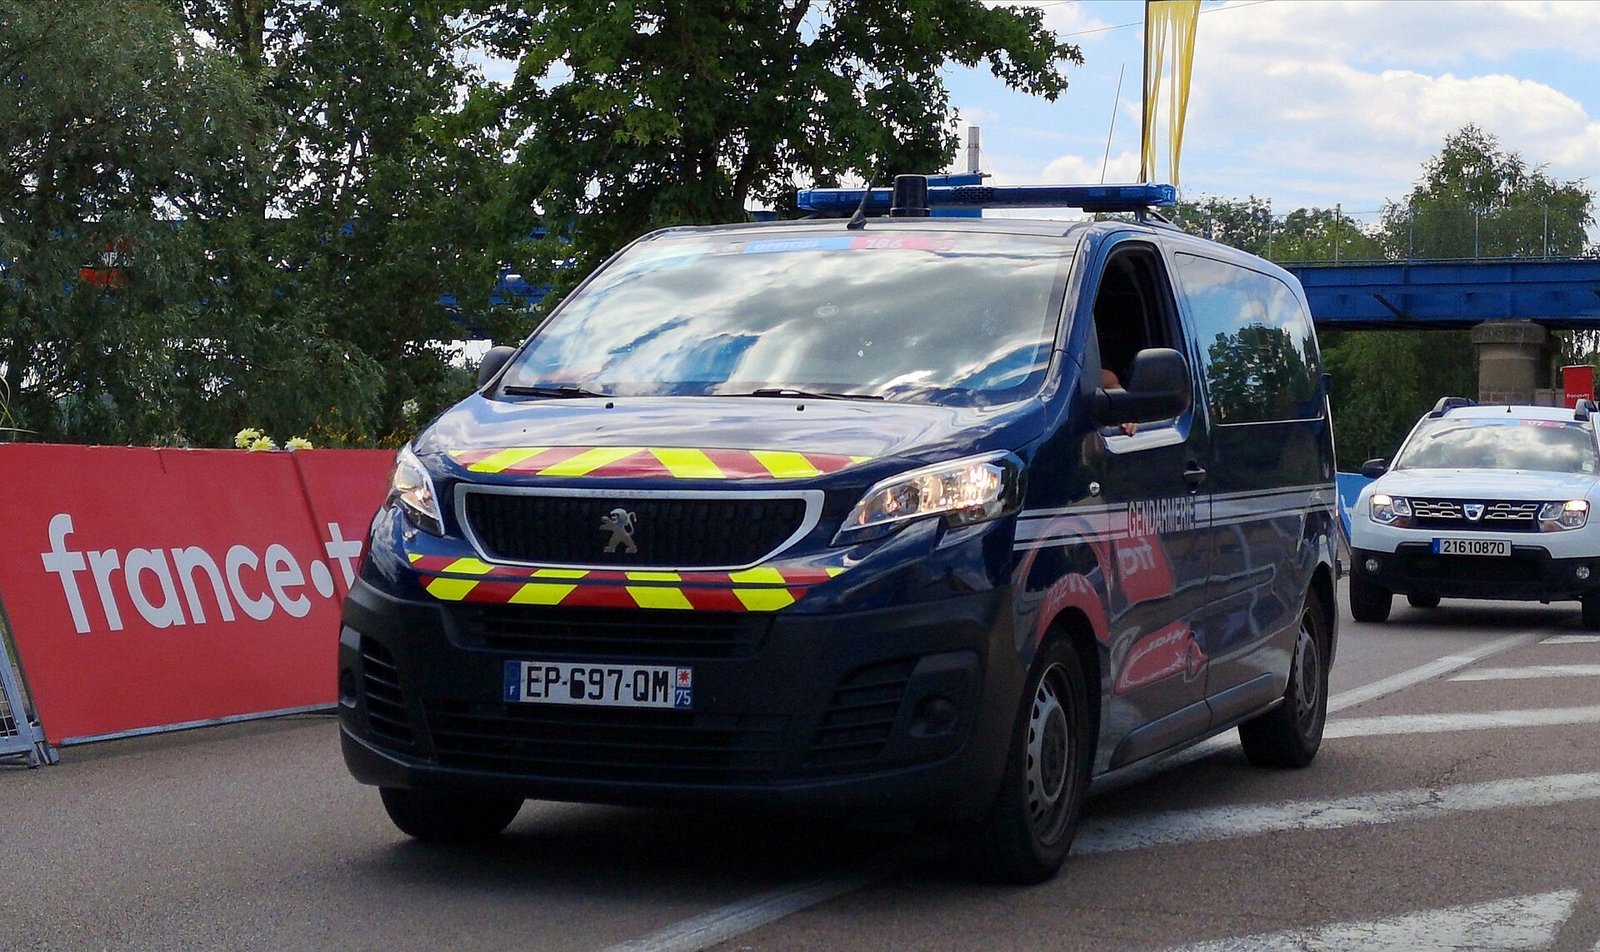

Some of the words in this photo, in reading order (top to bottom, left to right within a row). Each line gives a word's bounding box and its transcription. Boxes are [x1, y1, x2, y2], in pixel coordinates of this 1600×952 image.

[1128, 496, 1195, 538] GENDARMERIE
[1443, 540, 1505, 554] 21610870
[526, 666, 669, 703] EP-697-QM
[676, 689, 692, 706] 75
